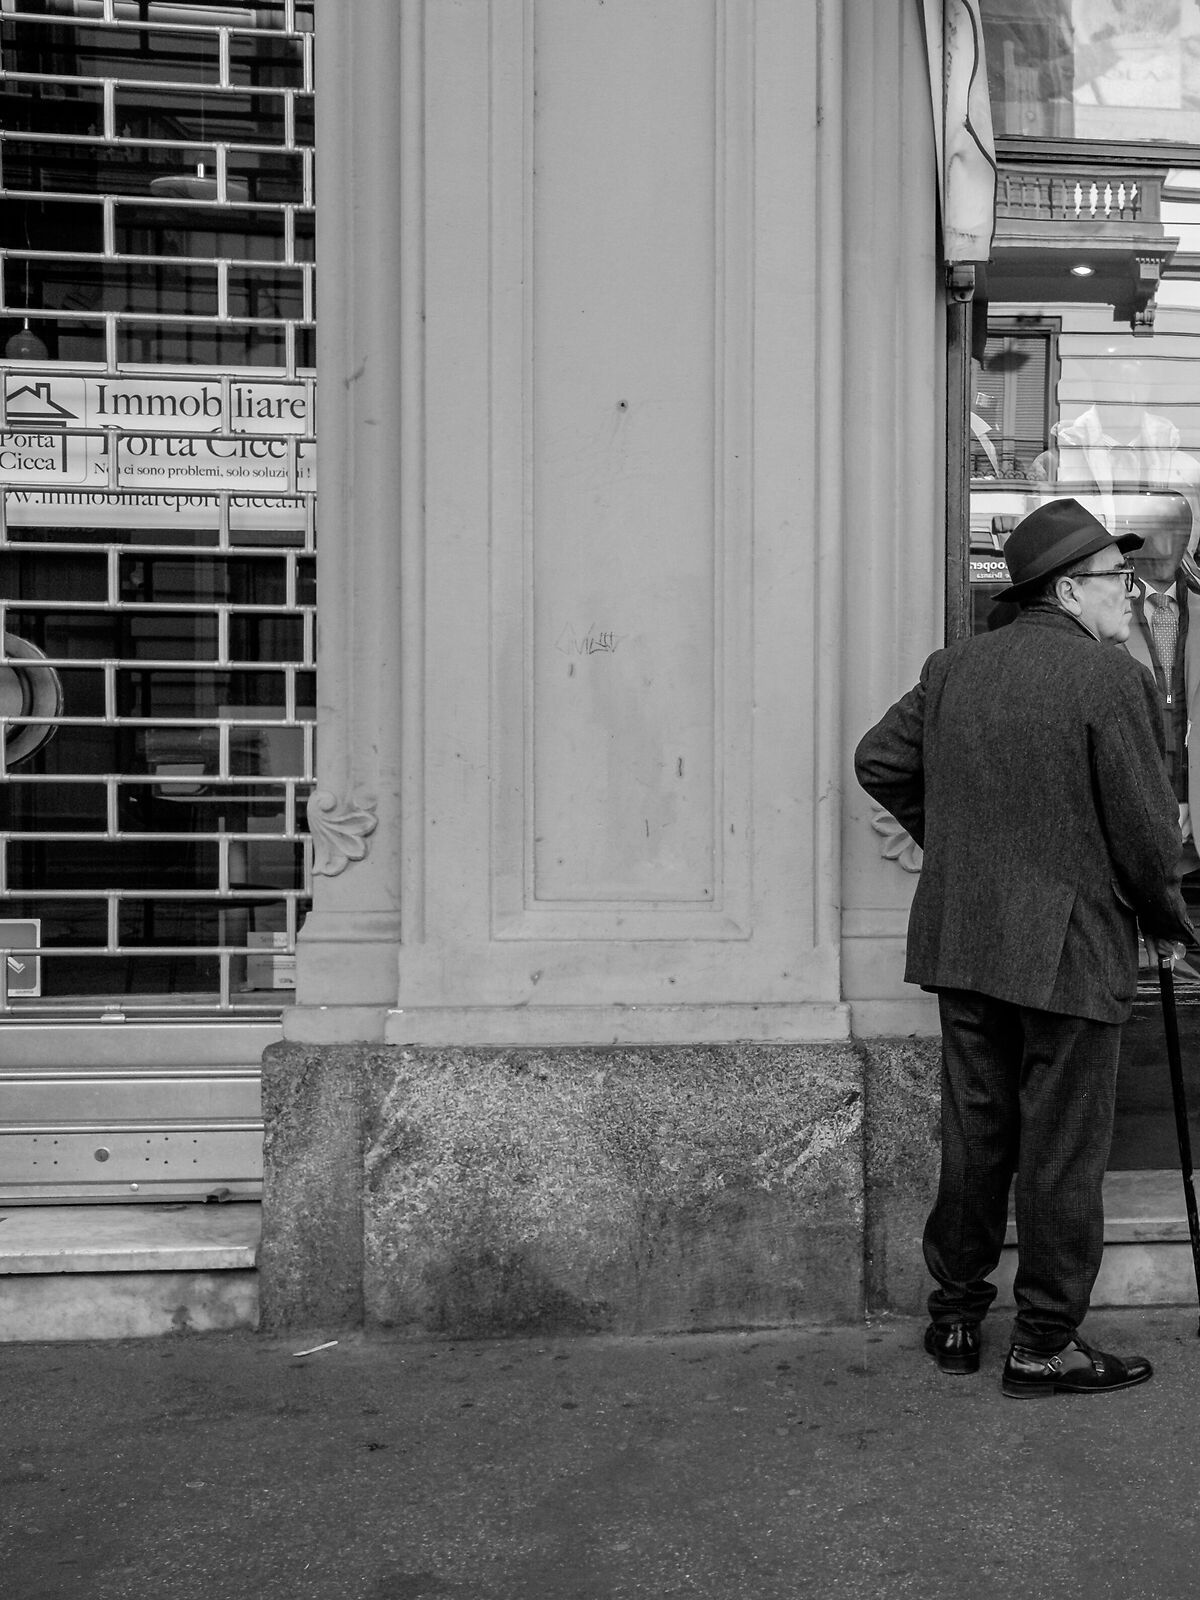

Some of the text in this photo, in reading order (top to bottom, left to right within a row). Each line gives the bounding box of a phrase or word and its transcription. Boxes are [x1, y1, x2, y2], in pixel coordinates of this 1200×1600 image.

[96, 384, 306, 419] Immobliare
[0, 432, 55, 448] Porta
[0, 451, 56, 471] Cicca
[124, 464, 134, 475] ci
[137, 467, 165, 476] sono
[168, 465, 223, 478] problemi,
[226, 466, 250, 477] solo
